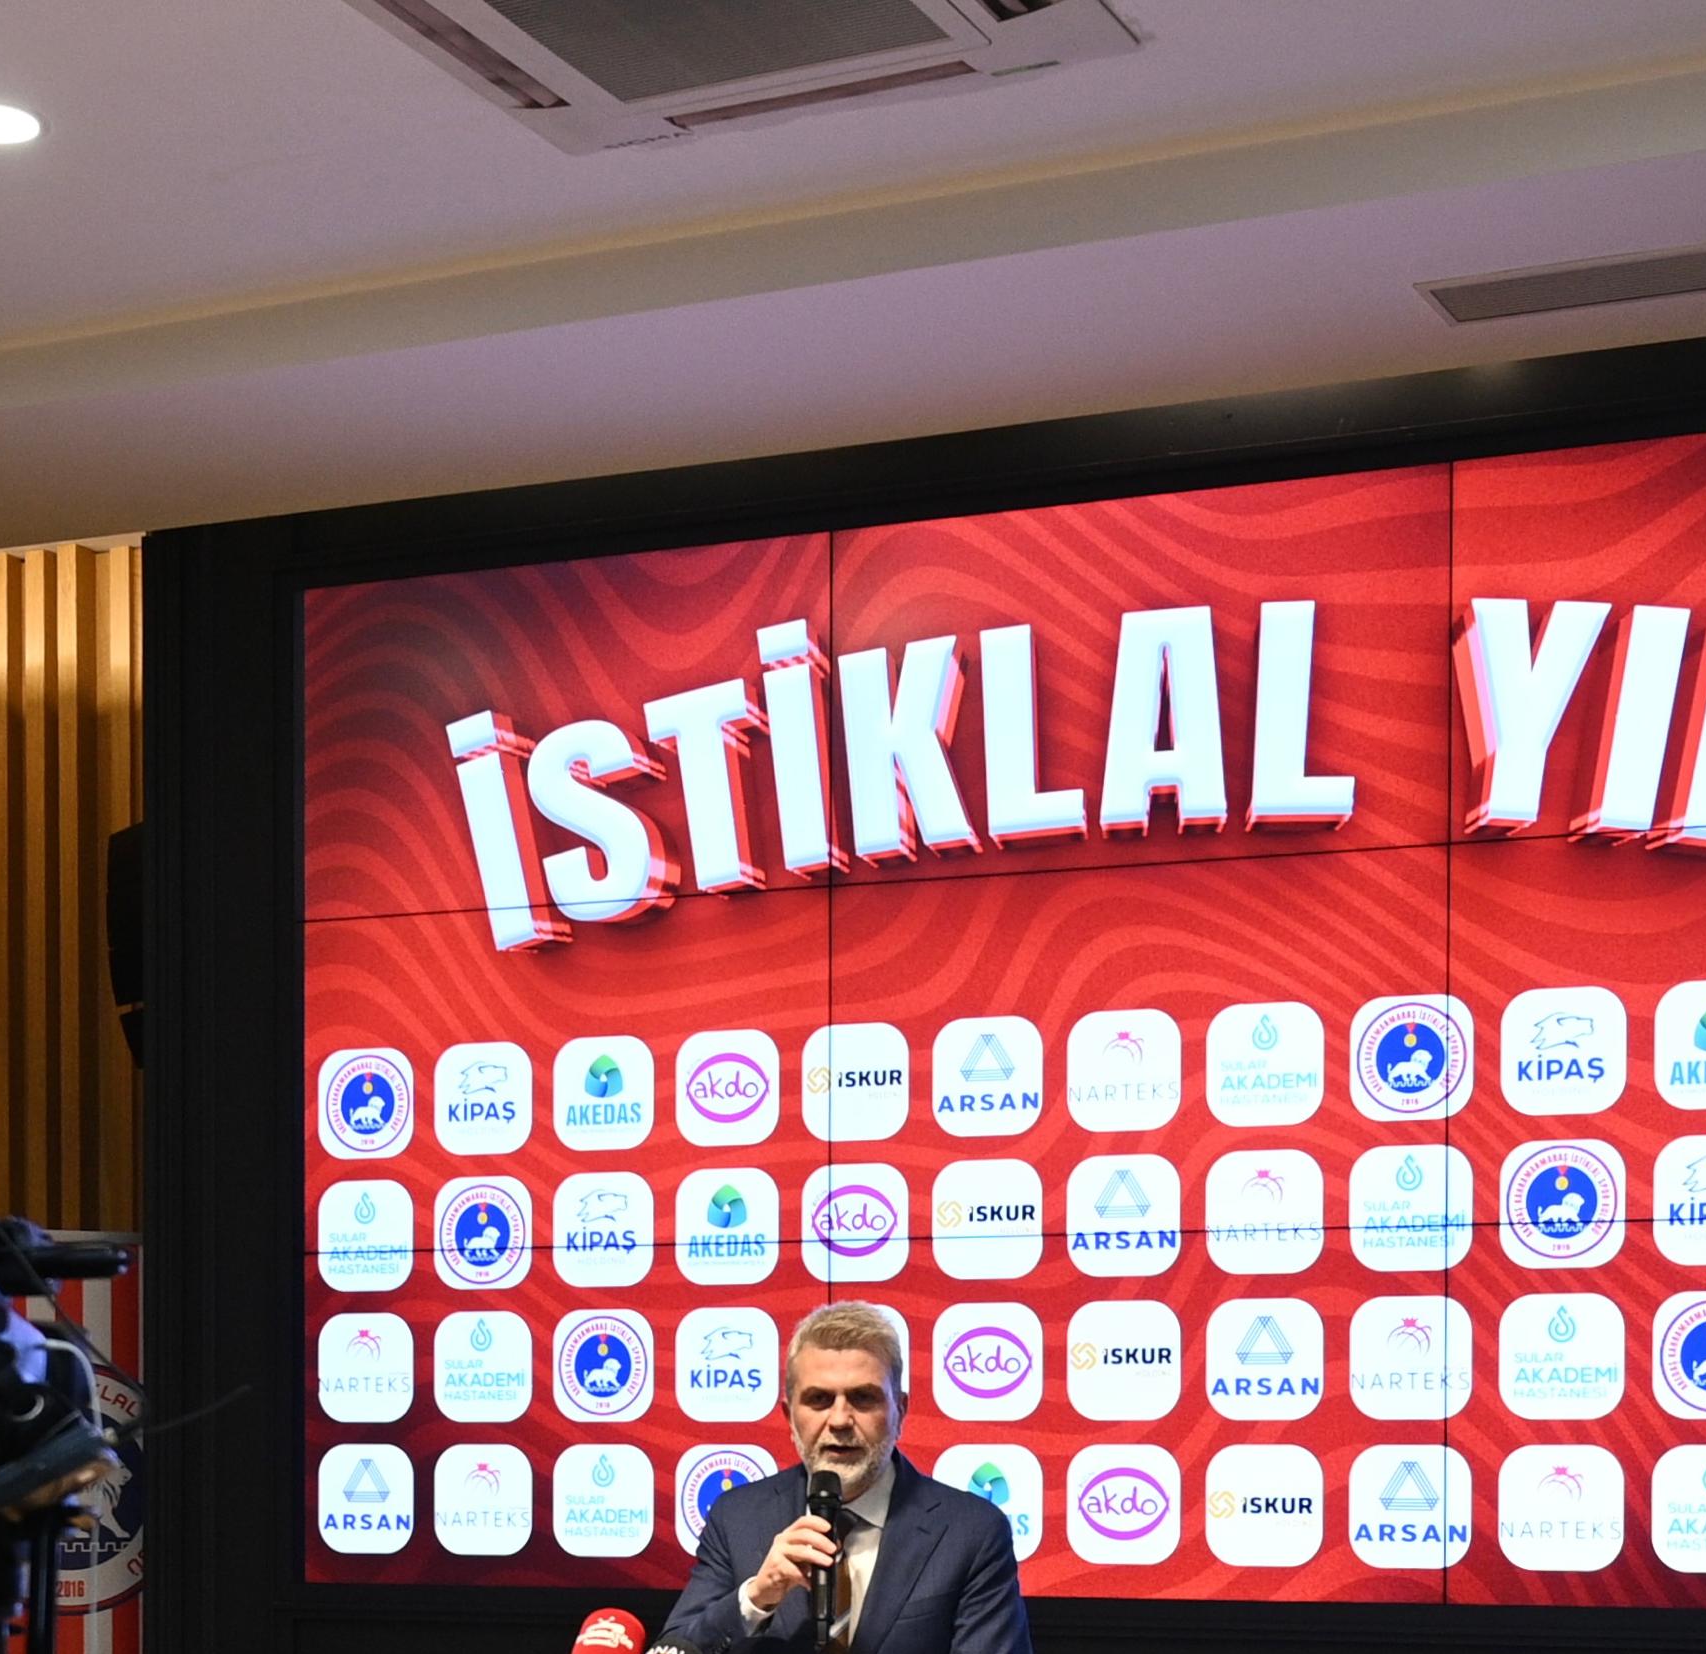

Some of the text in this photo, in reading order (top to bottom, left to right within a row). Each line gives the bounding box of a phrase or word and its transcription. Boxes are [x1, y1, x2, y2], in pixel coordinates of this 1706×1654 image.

[444, 599, 1357, 954] İSTİKLAL
[1518, 1054, 1605, 1083] KİPAŞ
[693, 1071, 759, 1099] akdo
[448, 1098, 515, 1123] KİPAŞ
[938, 1092, 1039, 1113] ARSAN
[819, 1203, 887, 1232] akdo
[567, 1226, 636, 1253] KİPAŞ
[1073, 1230, 1176, 1251] ARSAN
[952, 1345, 1021, 1375] akdo
[690, 1365, 762, 1392] KİPAŞ
[1212, 1377, 1319, 1396] ARSAN
[1087, 1486, 1157, 1516] akdo
[324, 1514, 411, 1531] ARSAN
[1355, 1524, 1467, 1543] ARSAN
